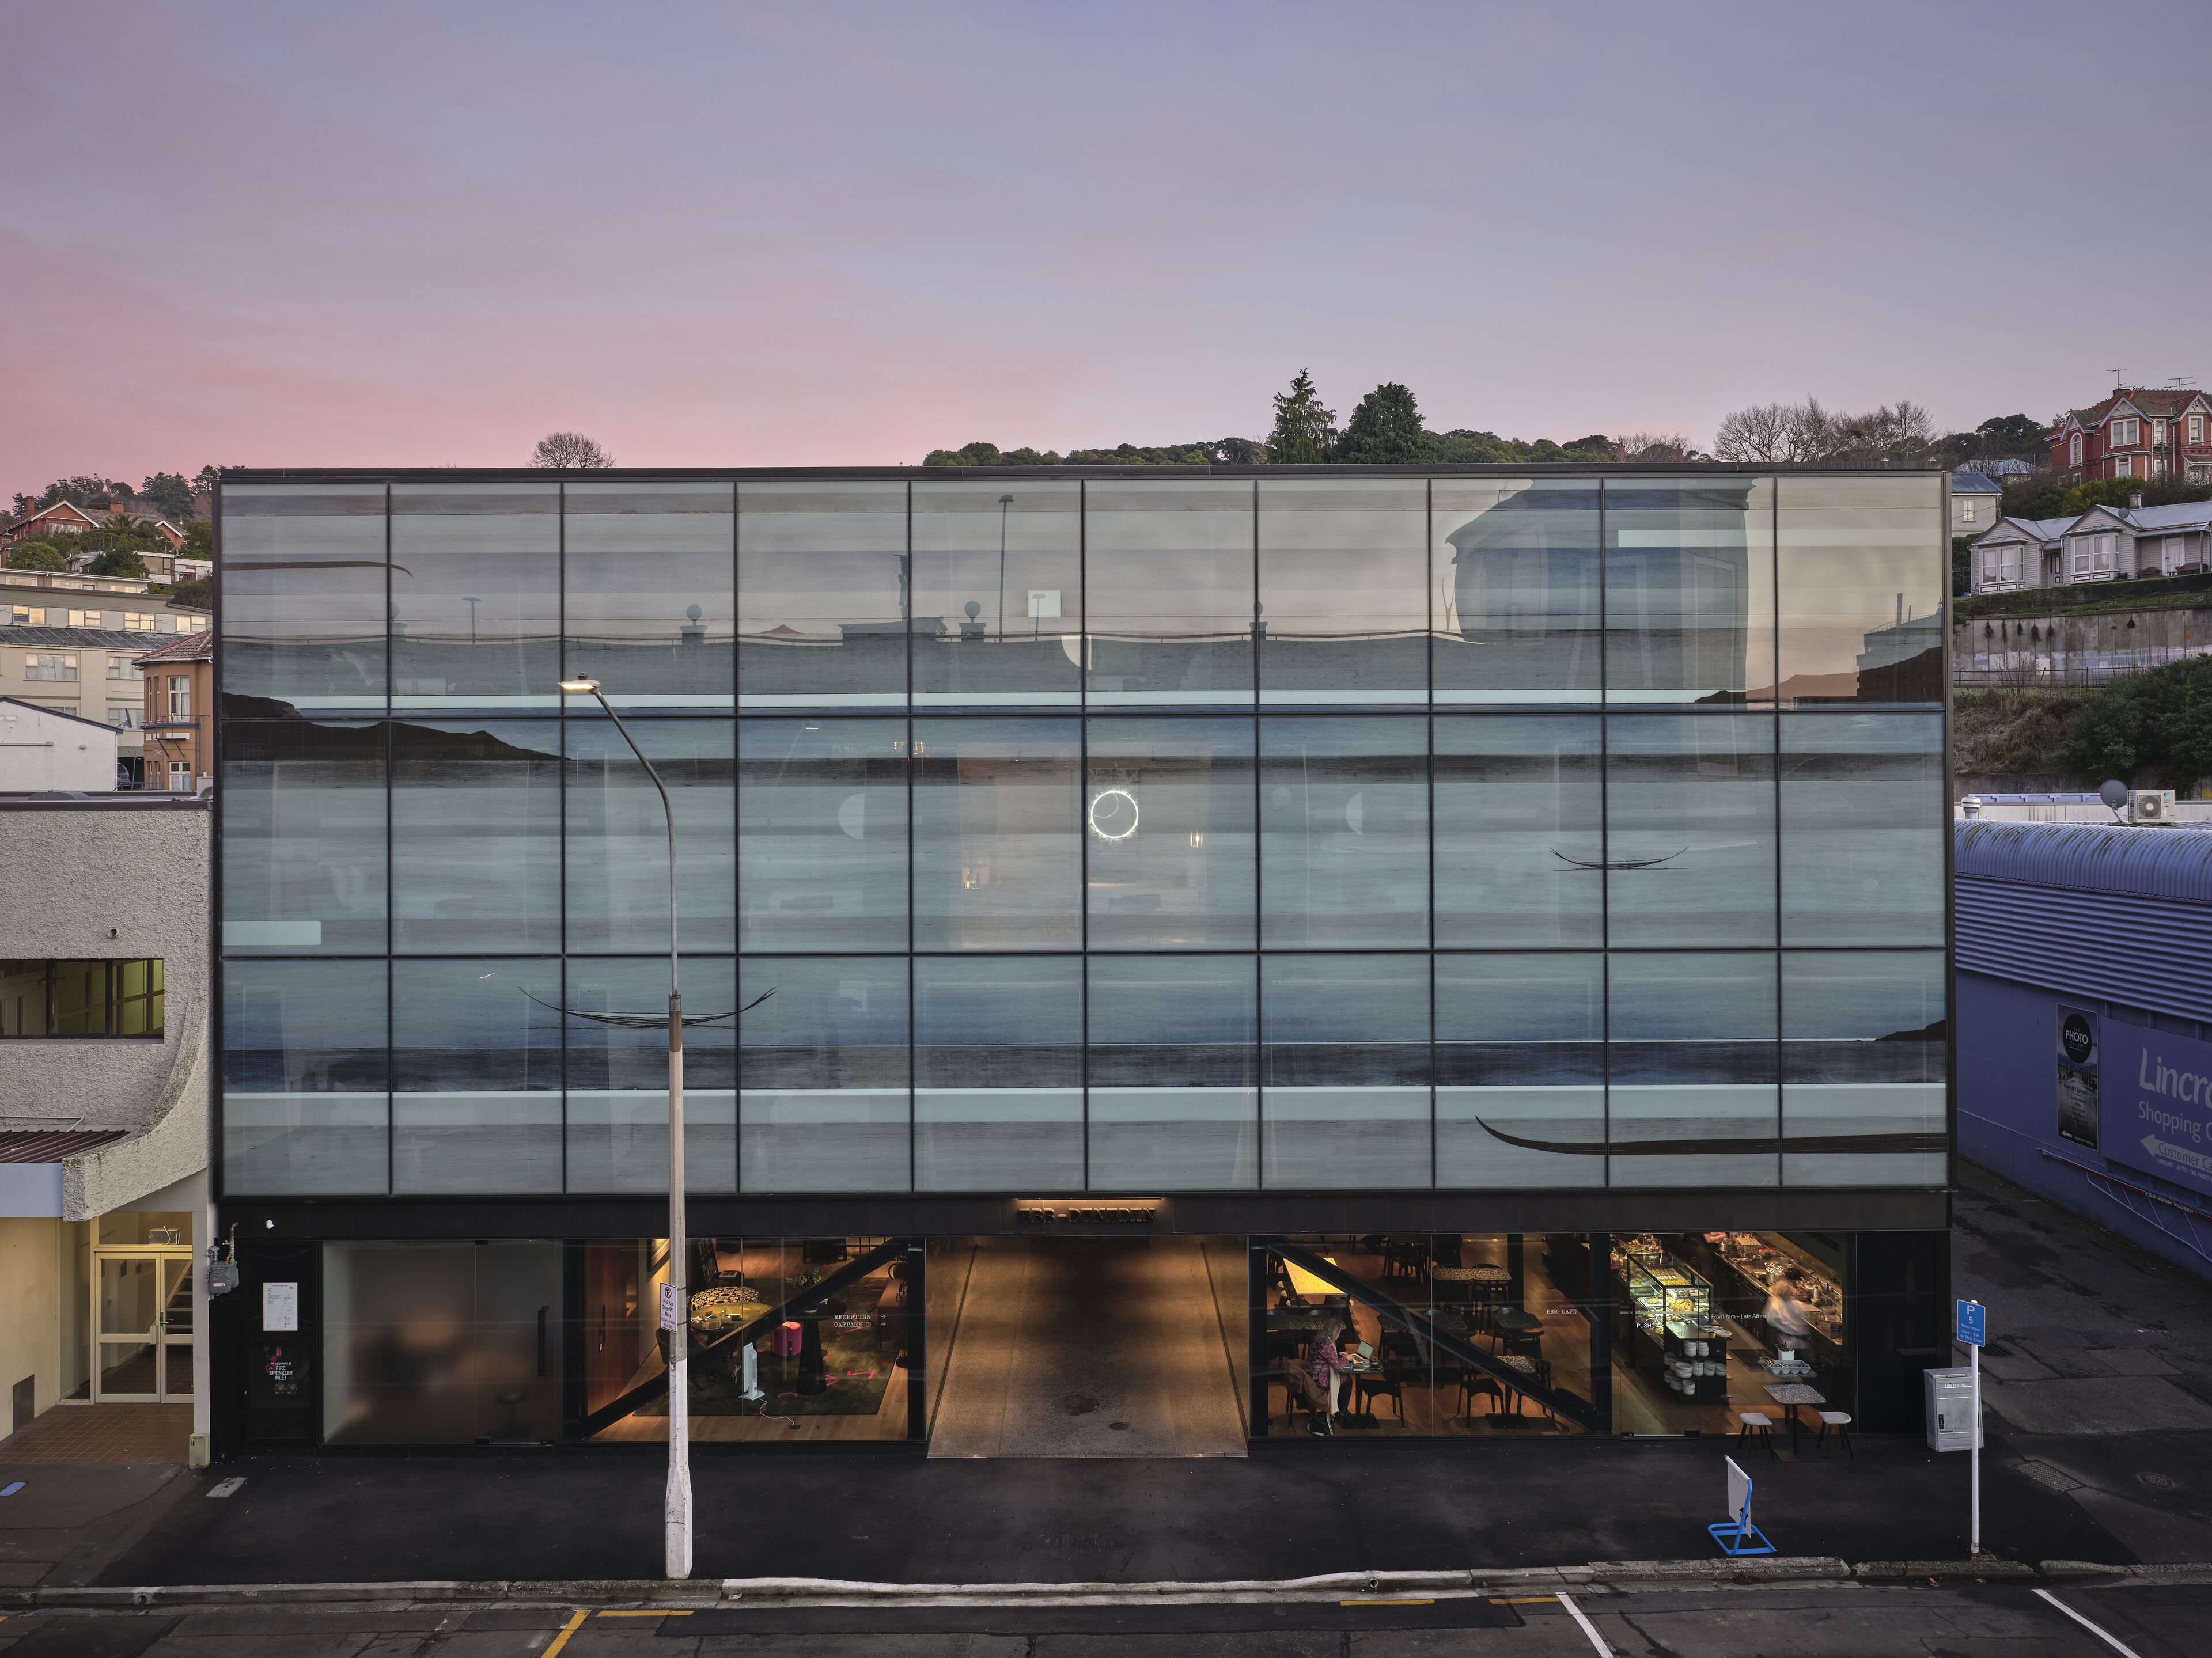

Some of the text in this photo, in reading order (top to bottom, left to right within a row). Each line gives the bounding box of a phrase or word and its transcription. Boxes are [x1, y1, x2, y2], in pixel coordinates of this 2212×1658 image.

[2066, 1030, 2088, 1044] PHOTO
[2139, 1101, 2202, 1143] Shopping
[2158, 1143, 2199, 1166] Customer
[2197, 1172, 2209, 1180] PHOTO
[2158, 1197, 2172, 1205] PARK
[2174, 1204, 2193, 1213] CLOSED
[1967, 1305, 1975, 1314] P
[1969, 1316, 1973, 1324] 5
